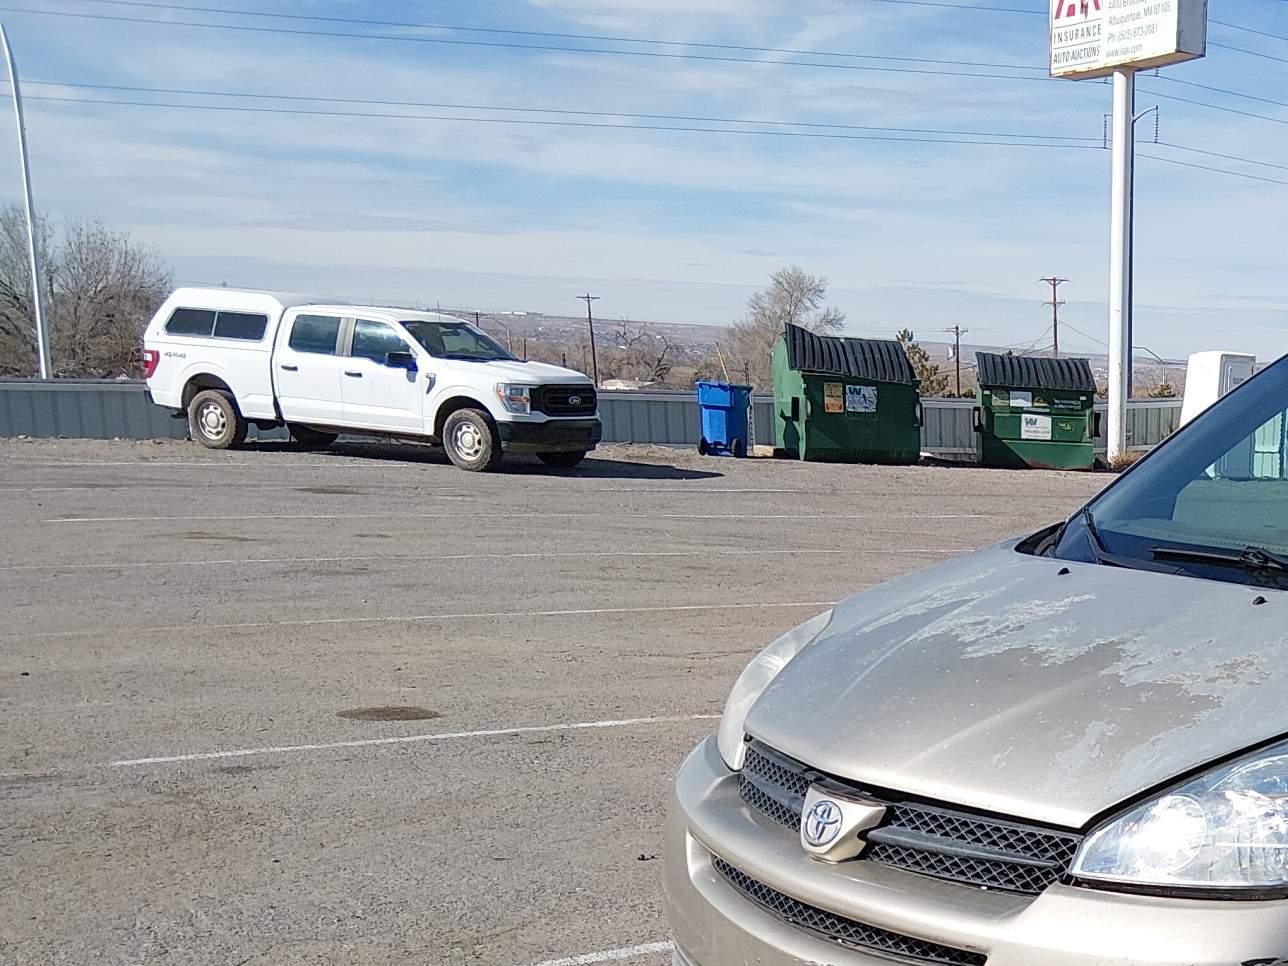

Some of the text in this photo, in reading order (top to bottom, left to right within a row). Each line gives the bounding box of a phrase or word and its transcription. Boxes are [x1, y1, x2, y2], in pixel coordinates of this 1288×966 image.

[1053, 23, 1102, 45] INSURANCE
[1053, 45, 1101, 65] AUTO AUCTIONS
